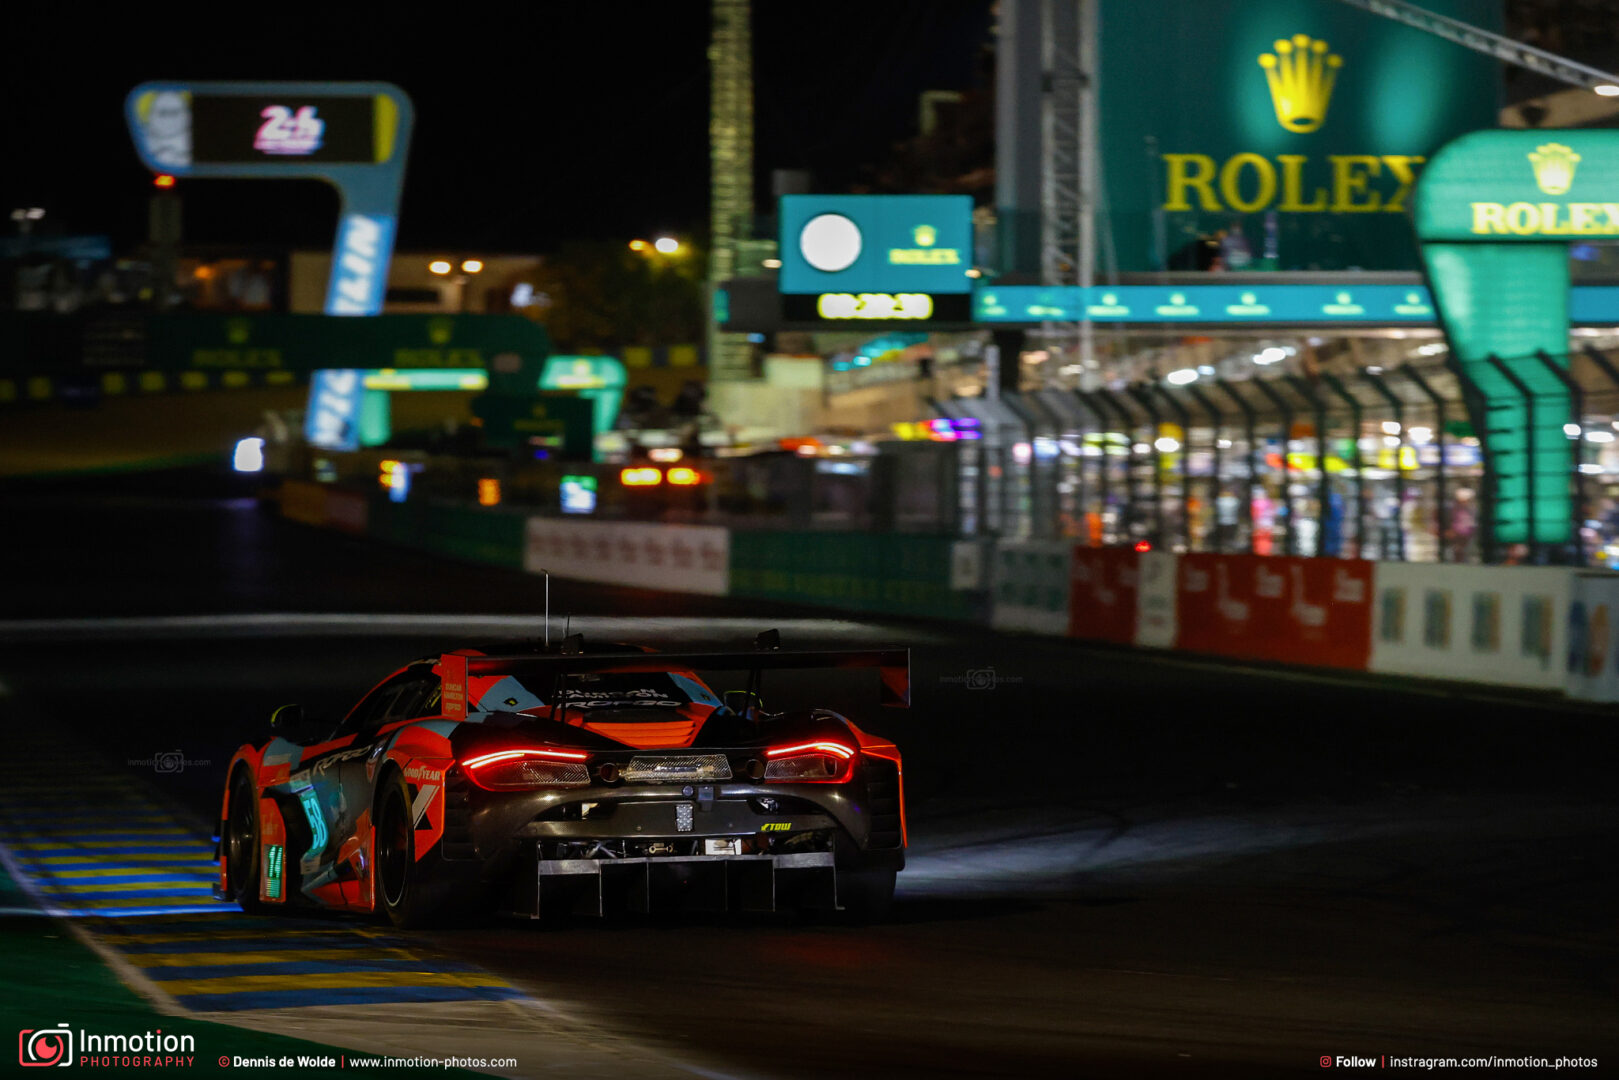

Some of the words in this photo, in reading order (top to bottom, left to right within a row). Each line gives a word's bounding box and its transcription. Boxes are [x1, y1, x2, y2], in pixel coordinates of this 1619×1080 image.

[1162, 152, 1428, 214] ROLEX
[1470, 202, 1619, 235] ROLEX
[303, 797, 328, 849] 58
